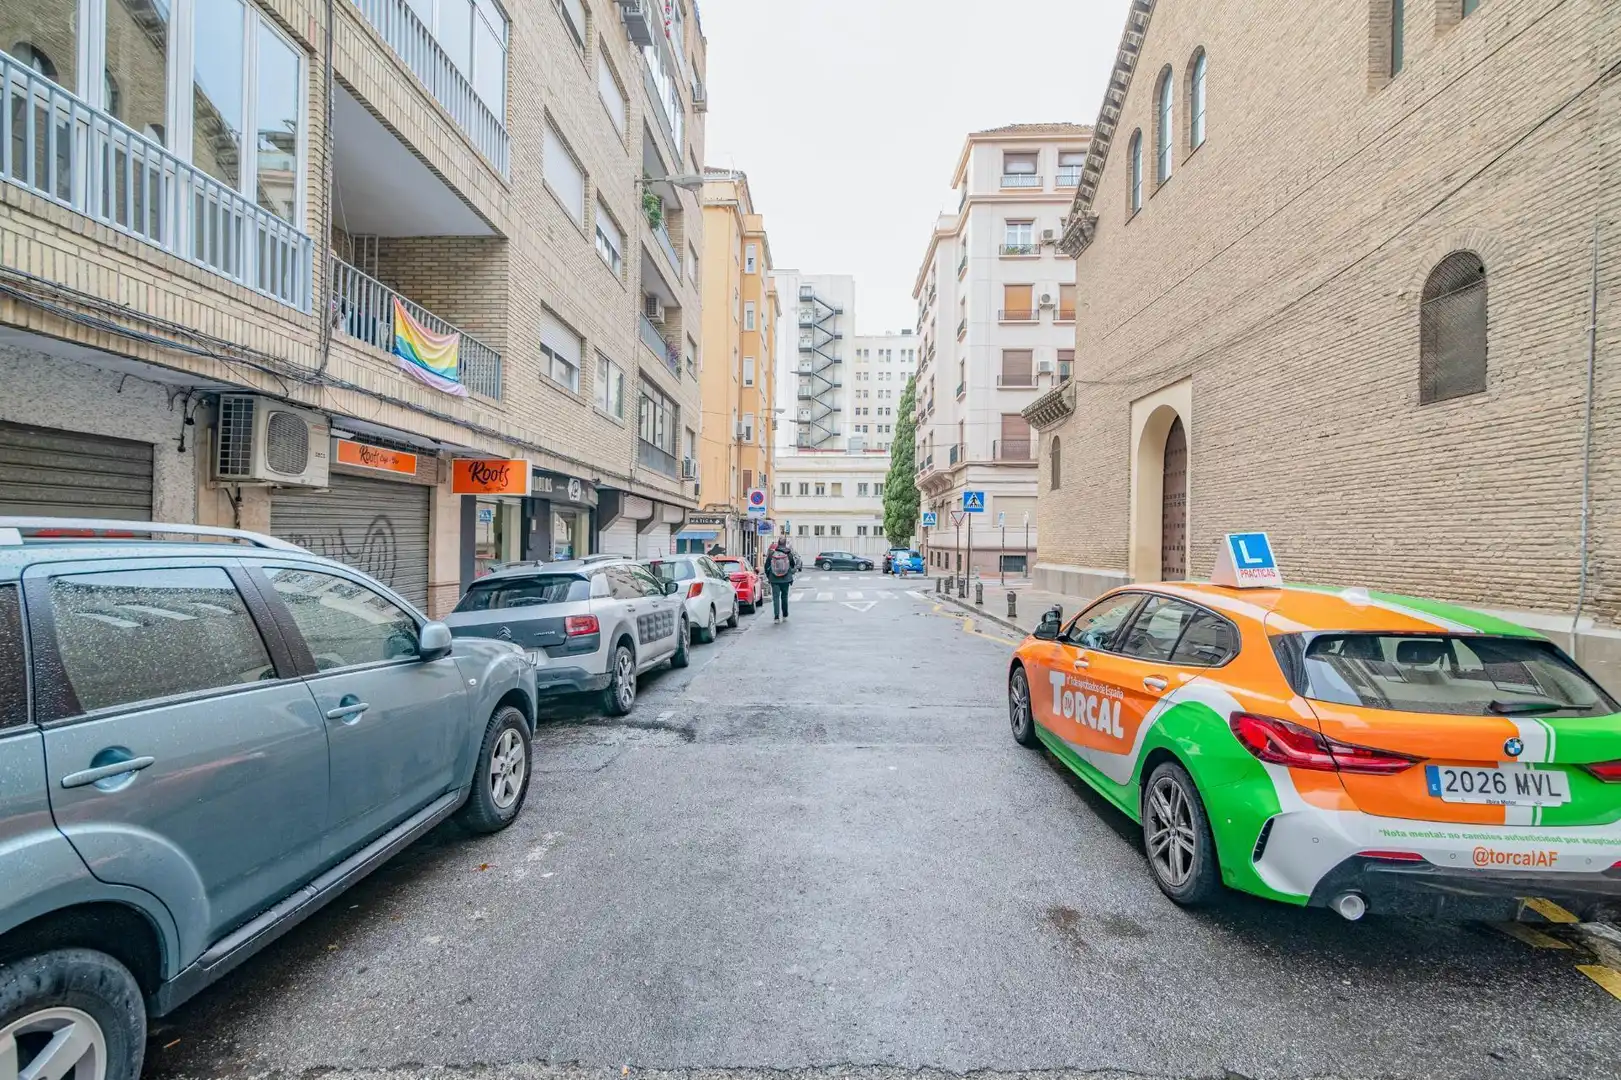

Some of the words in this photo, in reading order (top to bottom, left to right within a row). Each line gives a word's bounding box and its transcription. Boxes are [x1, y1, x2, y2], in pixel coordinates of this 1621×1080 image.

[468, 461, 510, 488] Roots
[1239, 540, 1263, 564] L
[1049, 670, 1124, 739] TORCAL
[1444, 770, 1507, 795] 2026
[1515, 772, 1562, 797] MVL
[1409, 831, 1447, 839] mental:
[1472, 846, 1559, 868] @torcalAF
